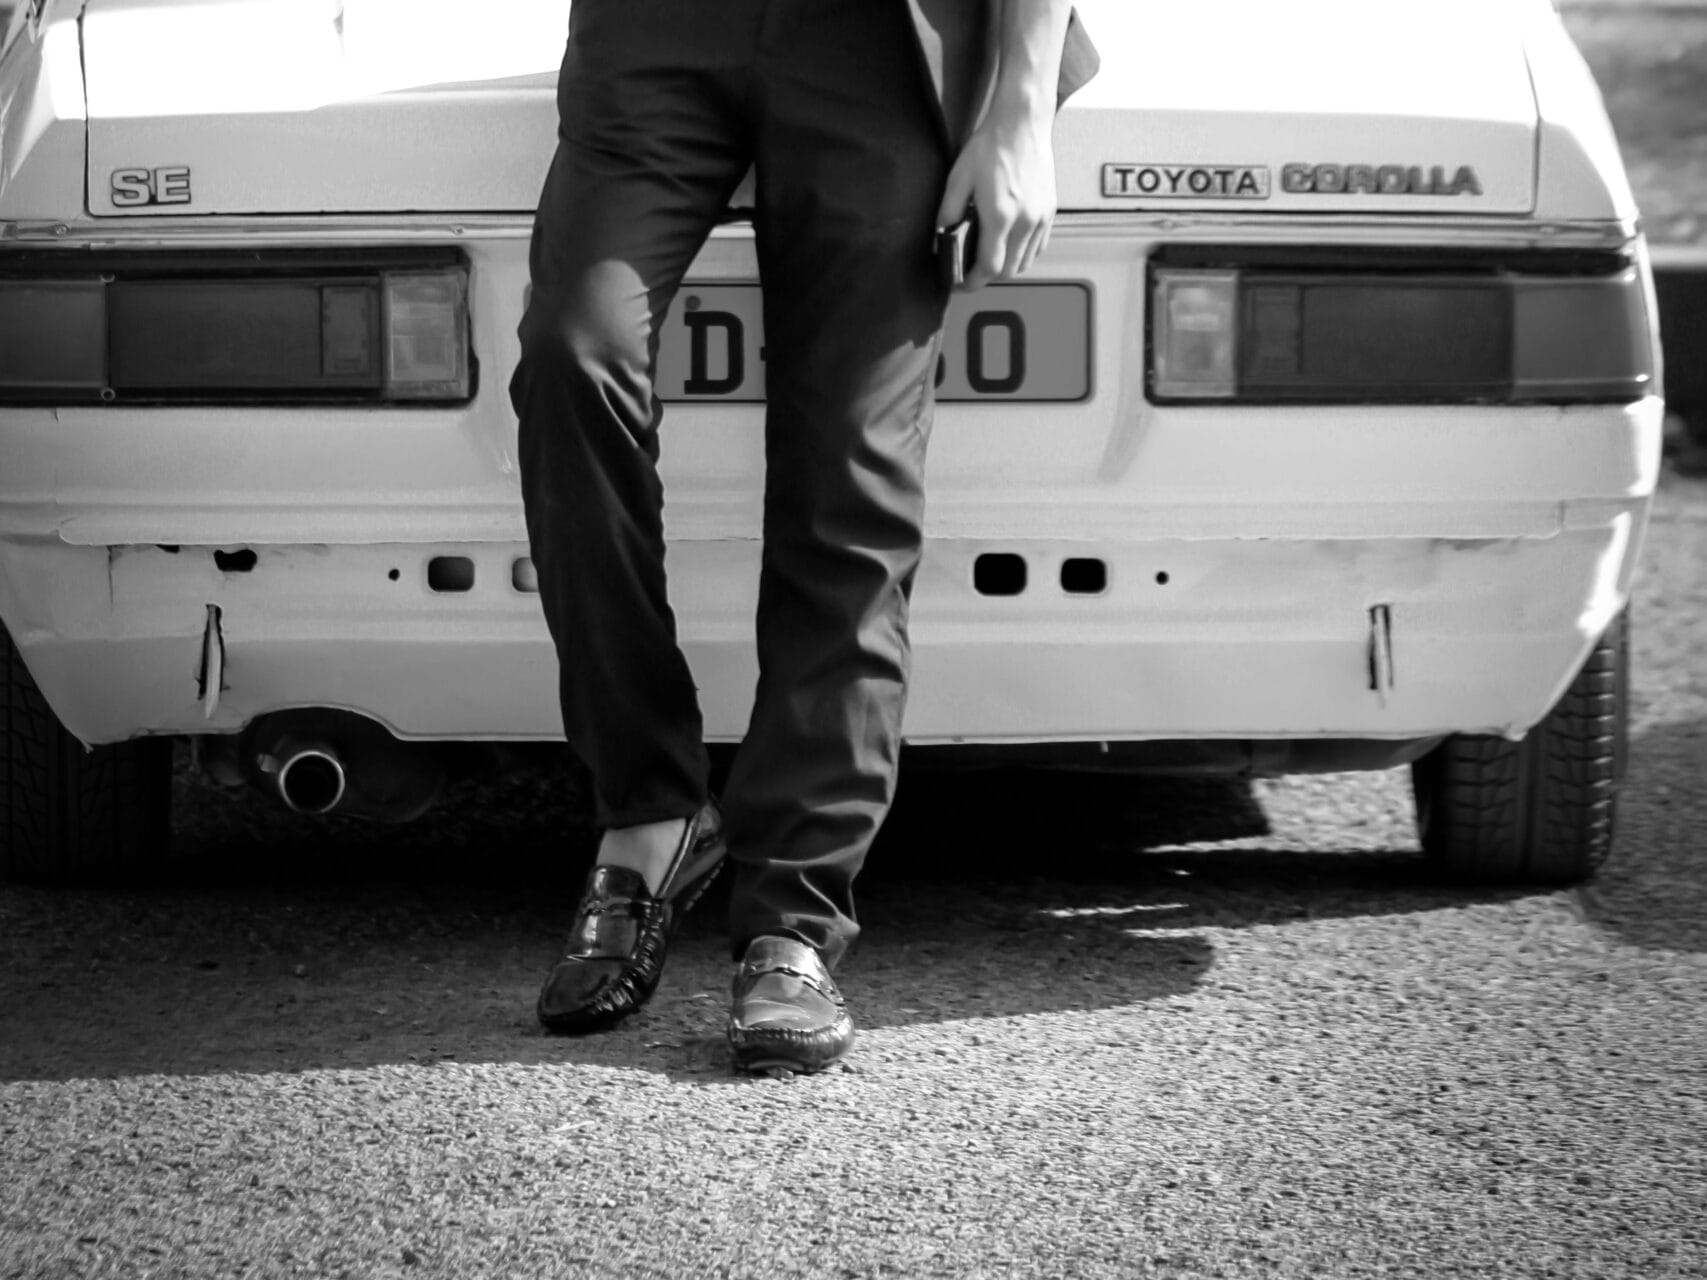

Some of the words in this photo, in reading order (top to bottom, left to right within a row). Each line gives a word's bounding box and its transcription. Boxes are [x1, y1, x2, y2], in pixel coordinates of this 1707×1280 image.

[110, 167, 192, 208] SE
[1114, 167, 1260, 194] TOYOTA
[1281, 163, 1484, 196] COROLLA
